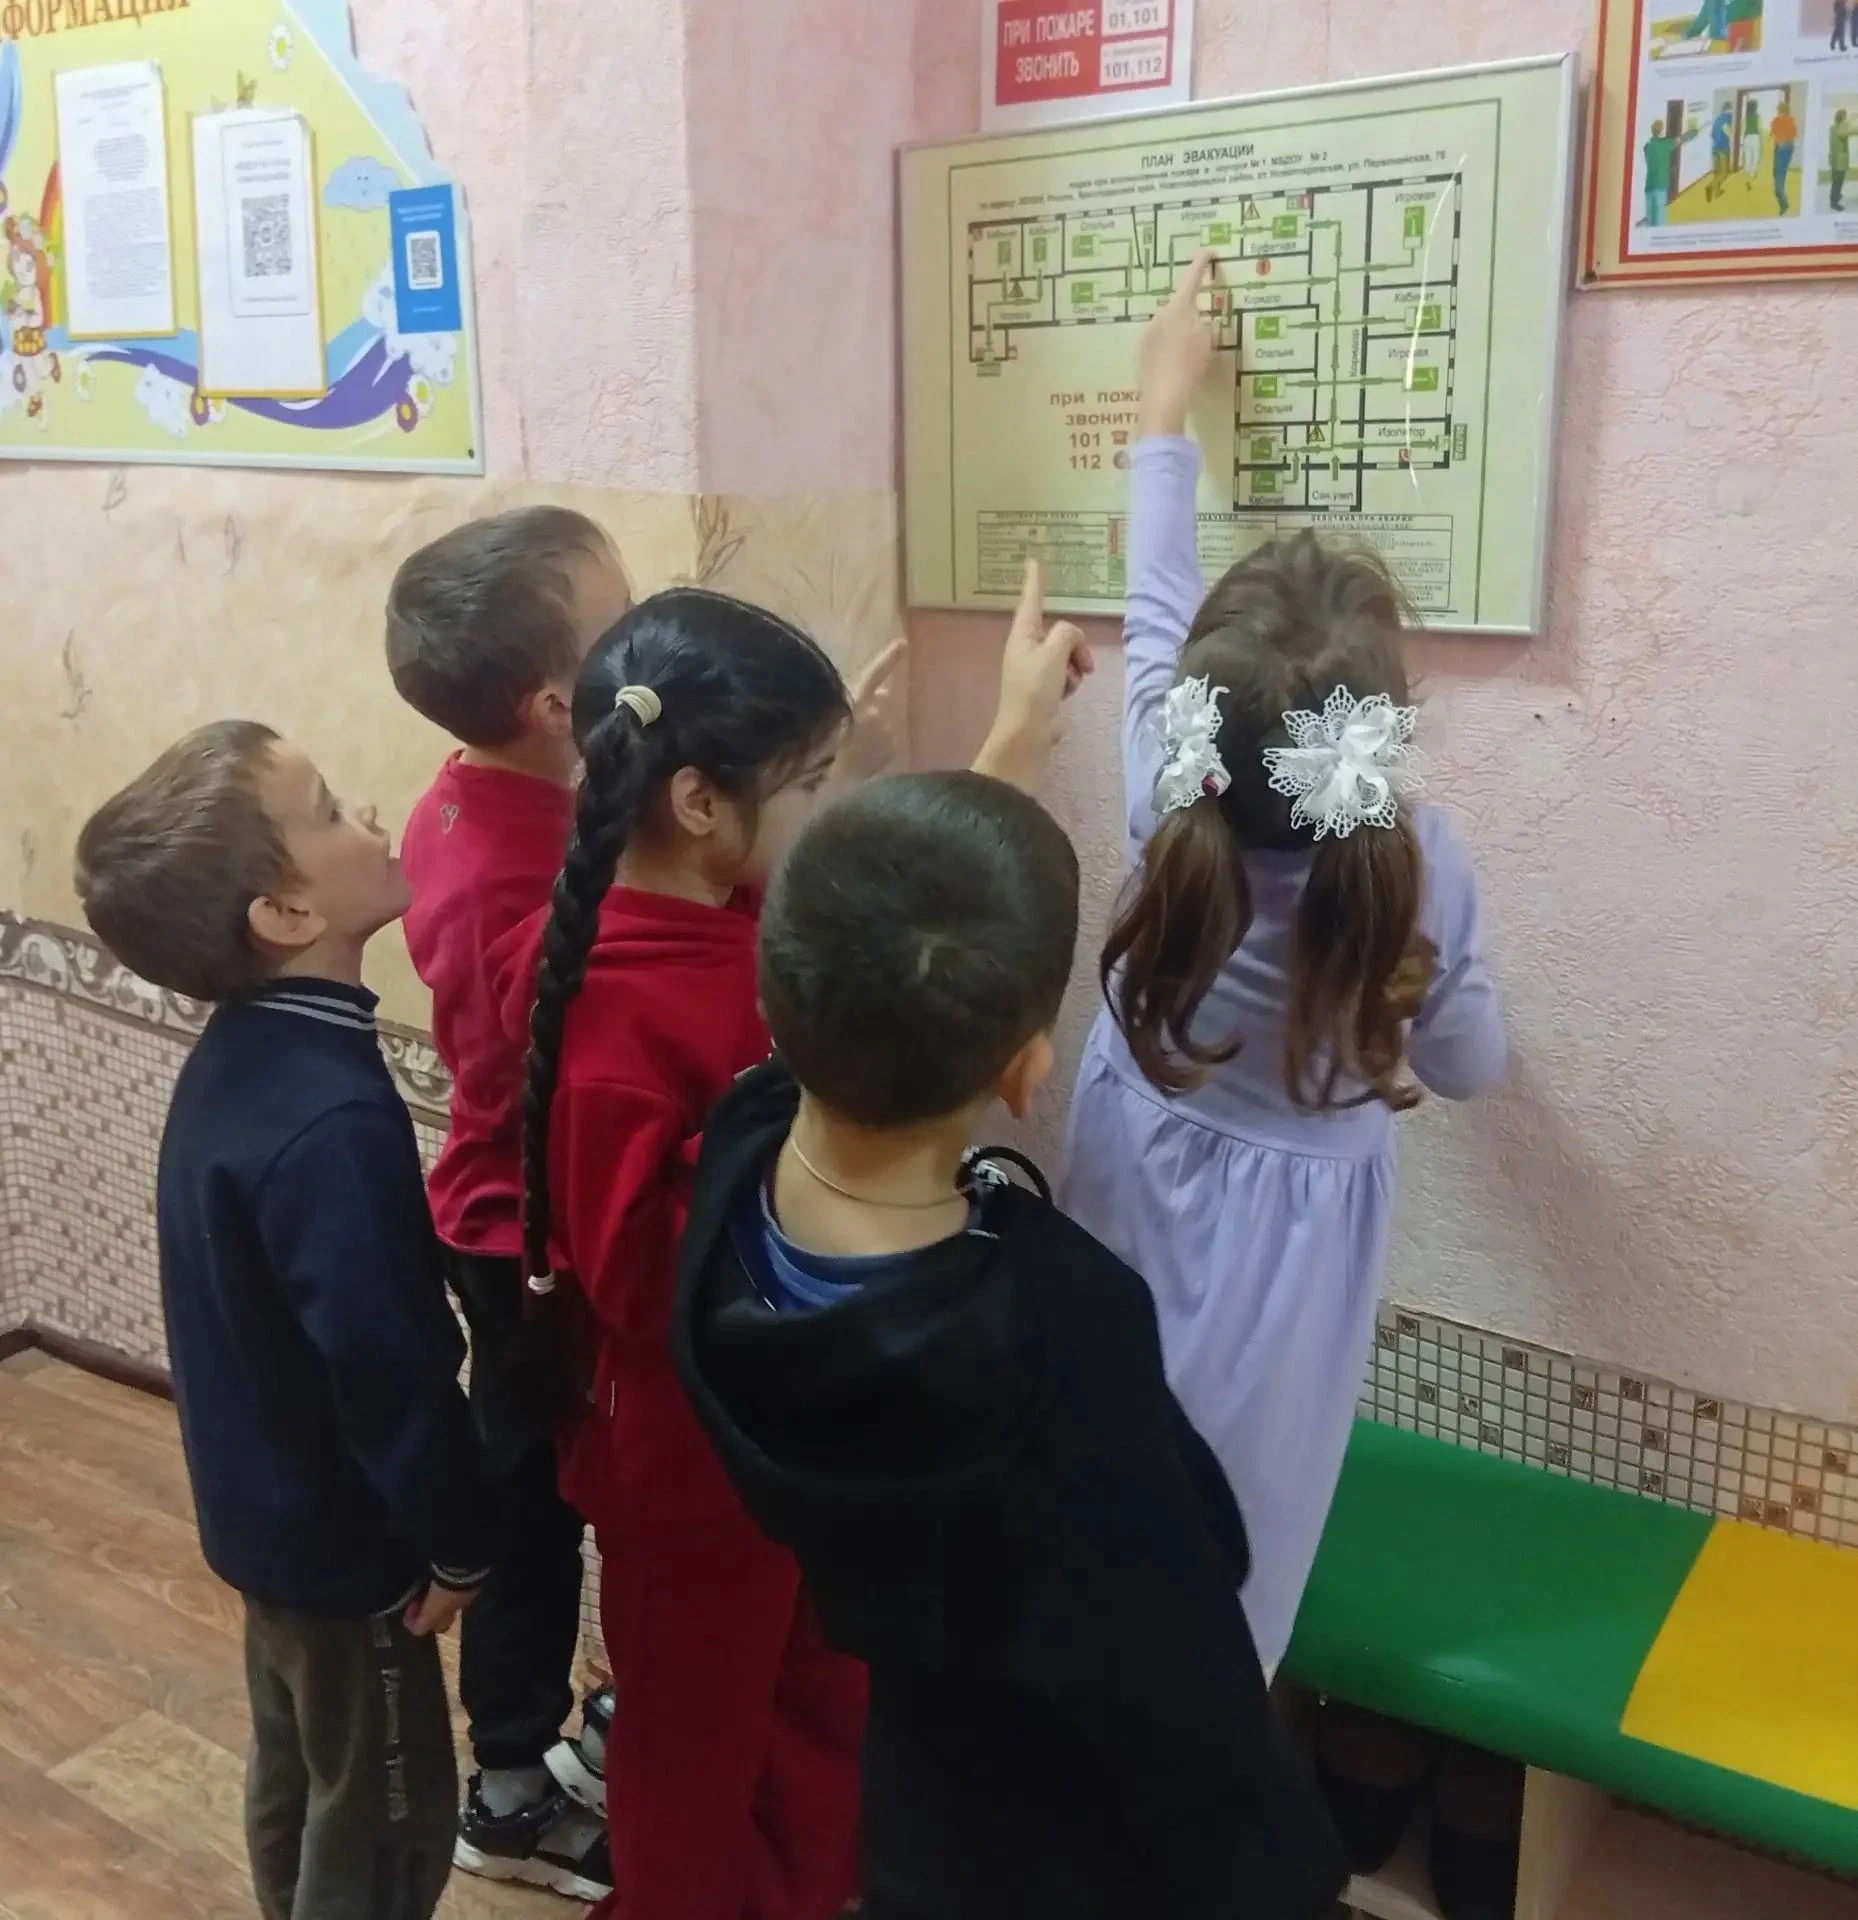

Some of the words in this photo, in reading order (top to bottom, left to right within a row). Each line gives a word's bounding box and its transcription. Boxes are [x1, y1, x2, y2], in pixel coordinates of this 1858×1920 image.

[2, 0, 190, 41] ФОРМАЦ
[1003, 17, 1032, 48] ПРИ
[1036, 8, 1095, 43] ПОЖАРЕ
[1015, 50, 1080, 84] ЗВОНИТЬ
[1141, 153, 1174, 169] ПЛАН
[1183, 143, 1255, 165] ЭВАКУАЦИИ
[1389, 348, 1429, 360] Игроая
[1049, 392, 1085, 408] при
[1069, 432, 1101, 449] 101
[1069, 453, 1102, 470] 112
